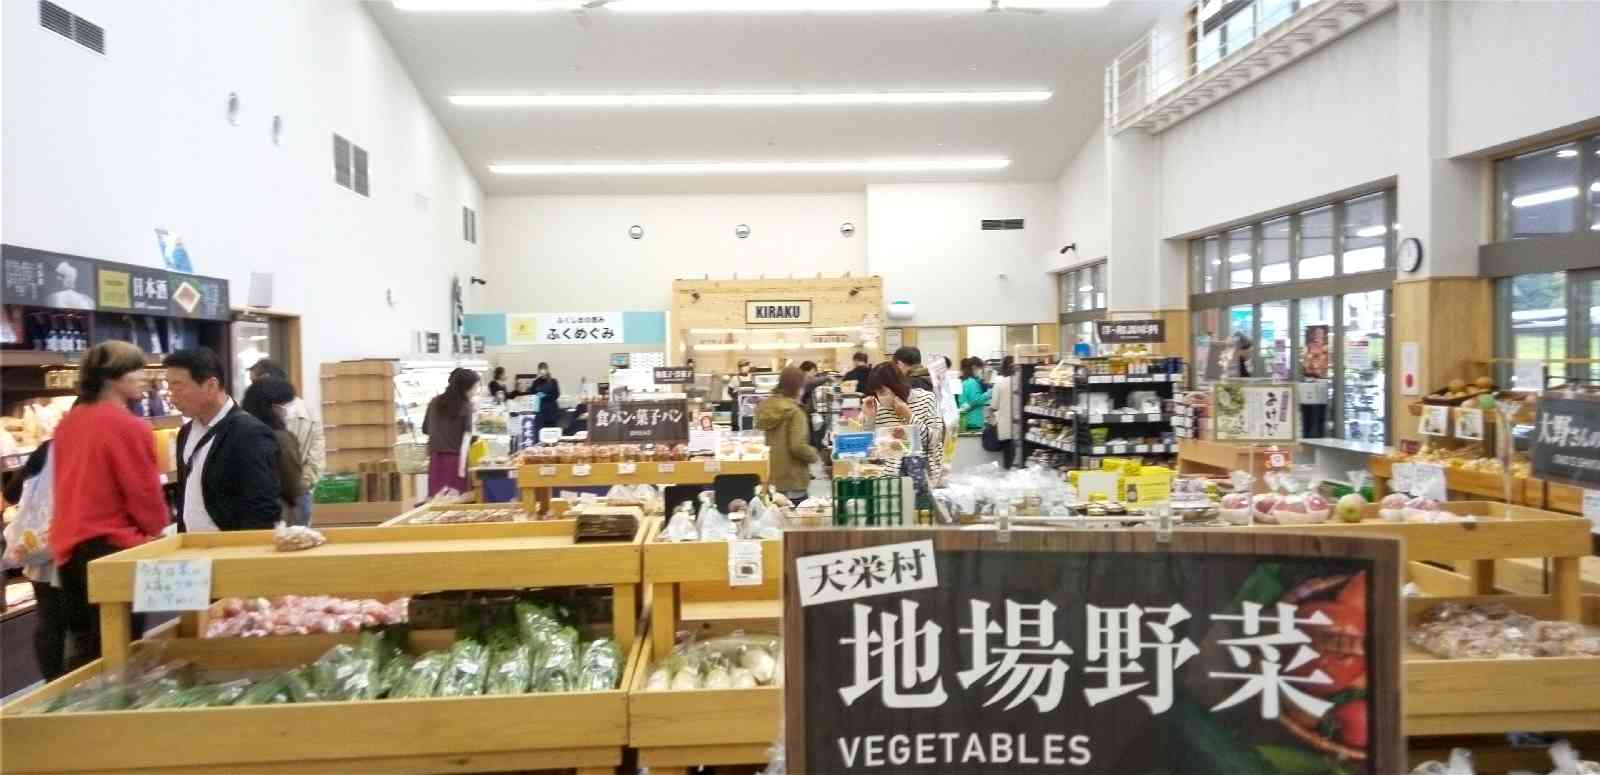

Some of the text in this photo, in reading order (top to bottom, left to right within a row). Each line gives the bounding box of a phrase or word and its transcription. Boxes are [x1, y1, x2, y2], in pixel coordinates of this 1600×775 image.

[133, 277, 168, 299] 日本酒
[755, 305, 801, 319] KIRAKU
[547, 327, 615, 340] ふくめぐみ
[595, 408, 684, 427] 食パン・菓子パン
[807, 548, 927, 598] 天栄村
[838, 598, 1334, 720] 地場野菜
[838, 732, 1092, 768] VEGETABLES
